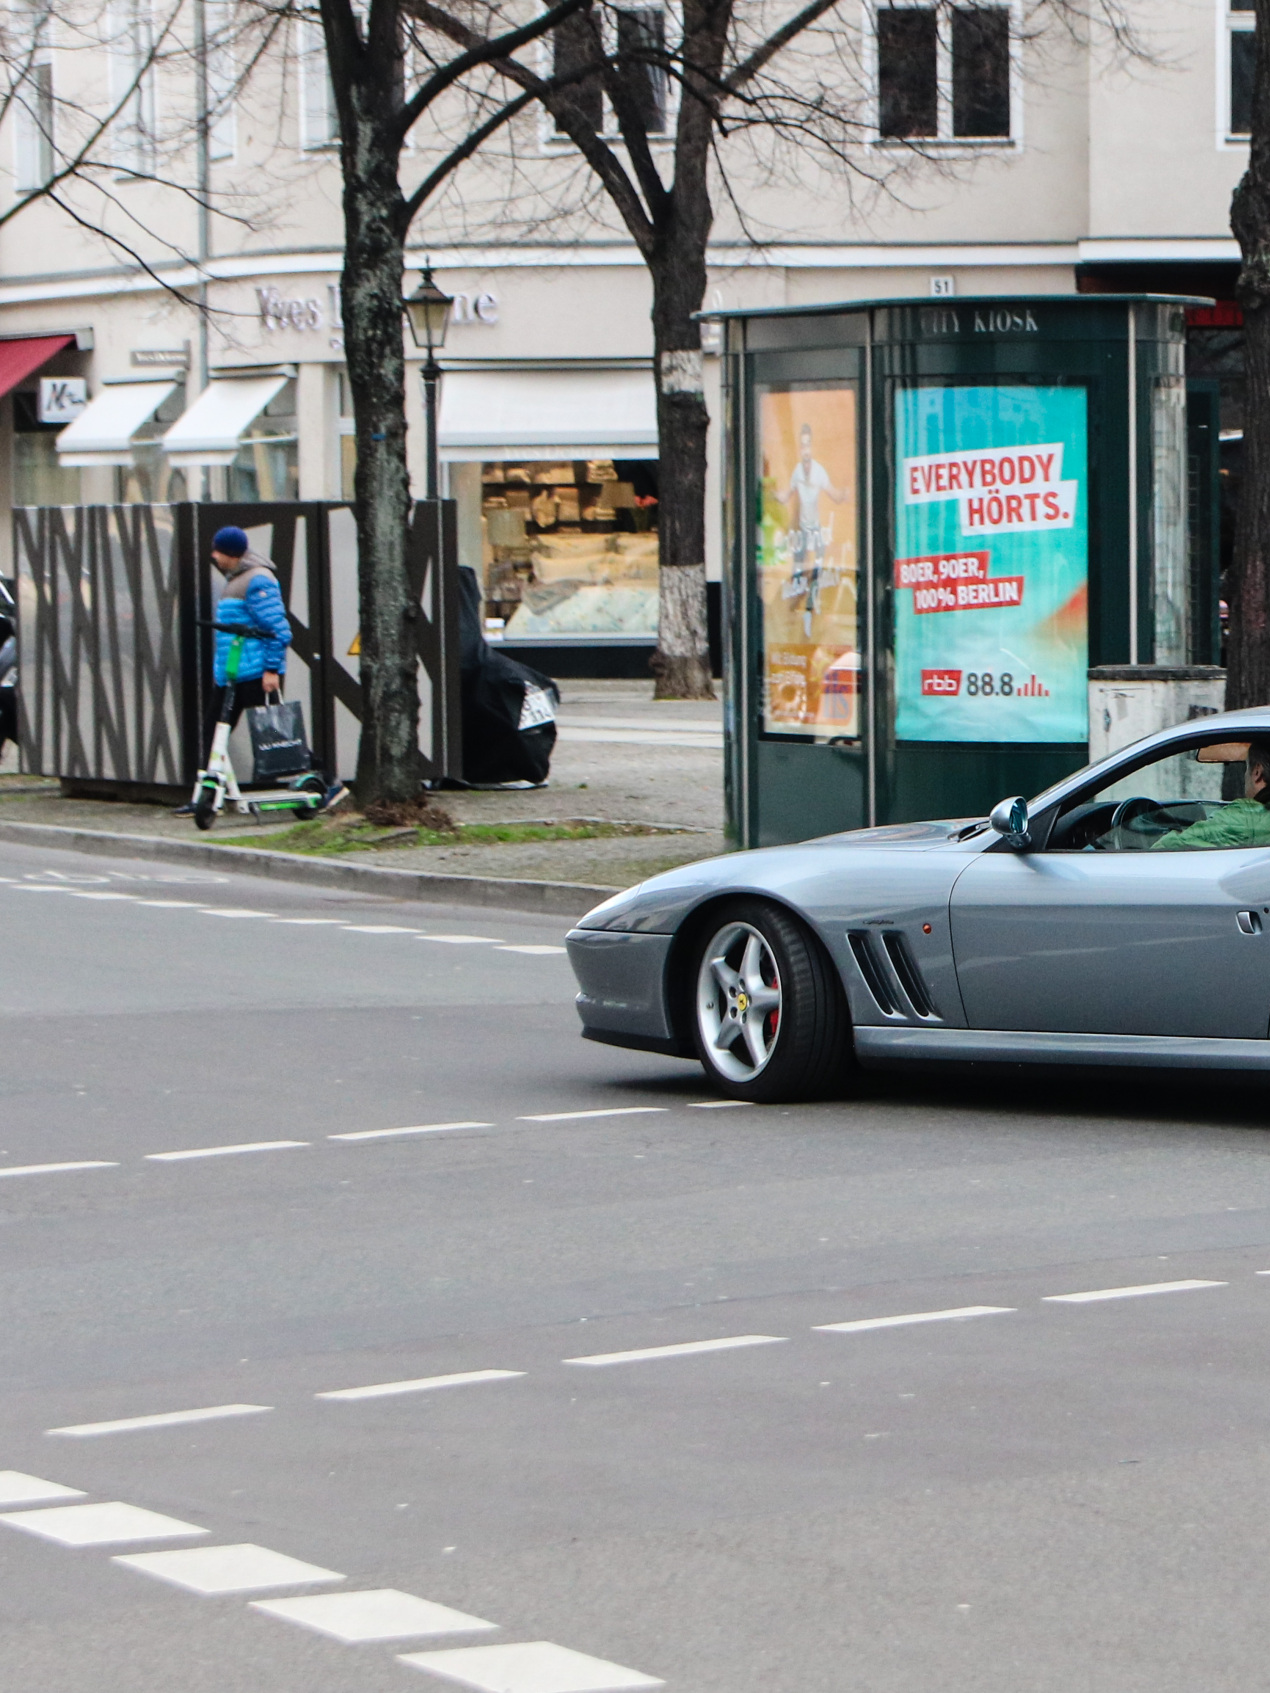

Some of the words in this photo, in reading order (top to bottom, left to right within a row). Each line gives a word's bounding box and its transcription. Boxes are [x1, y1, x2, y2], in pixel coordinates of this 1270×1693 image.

[934, 280, 950, 294] 51
[974, 308, 1039, 333] KIOSK
[909, 453, 1055, 496] EVERYBODY
[968, 488, 1070, 527] HÖRTS.
[901, 561, 938, 584] 80ER,
[939, 557, 985, 580] 90ER,
[915, 587, 956, 609] 100%
[957, 581, 1019, 605] BERLIN
[923, 674, 957, 691] rbb
[967, 672, 1013, 697] 88.8
